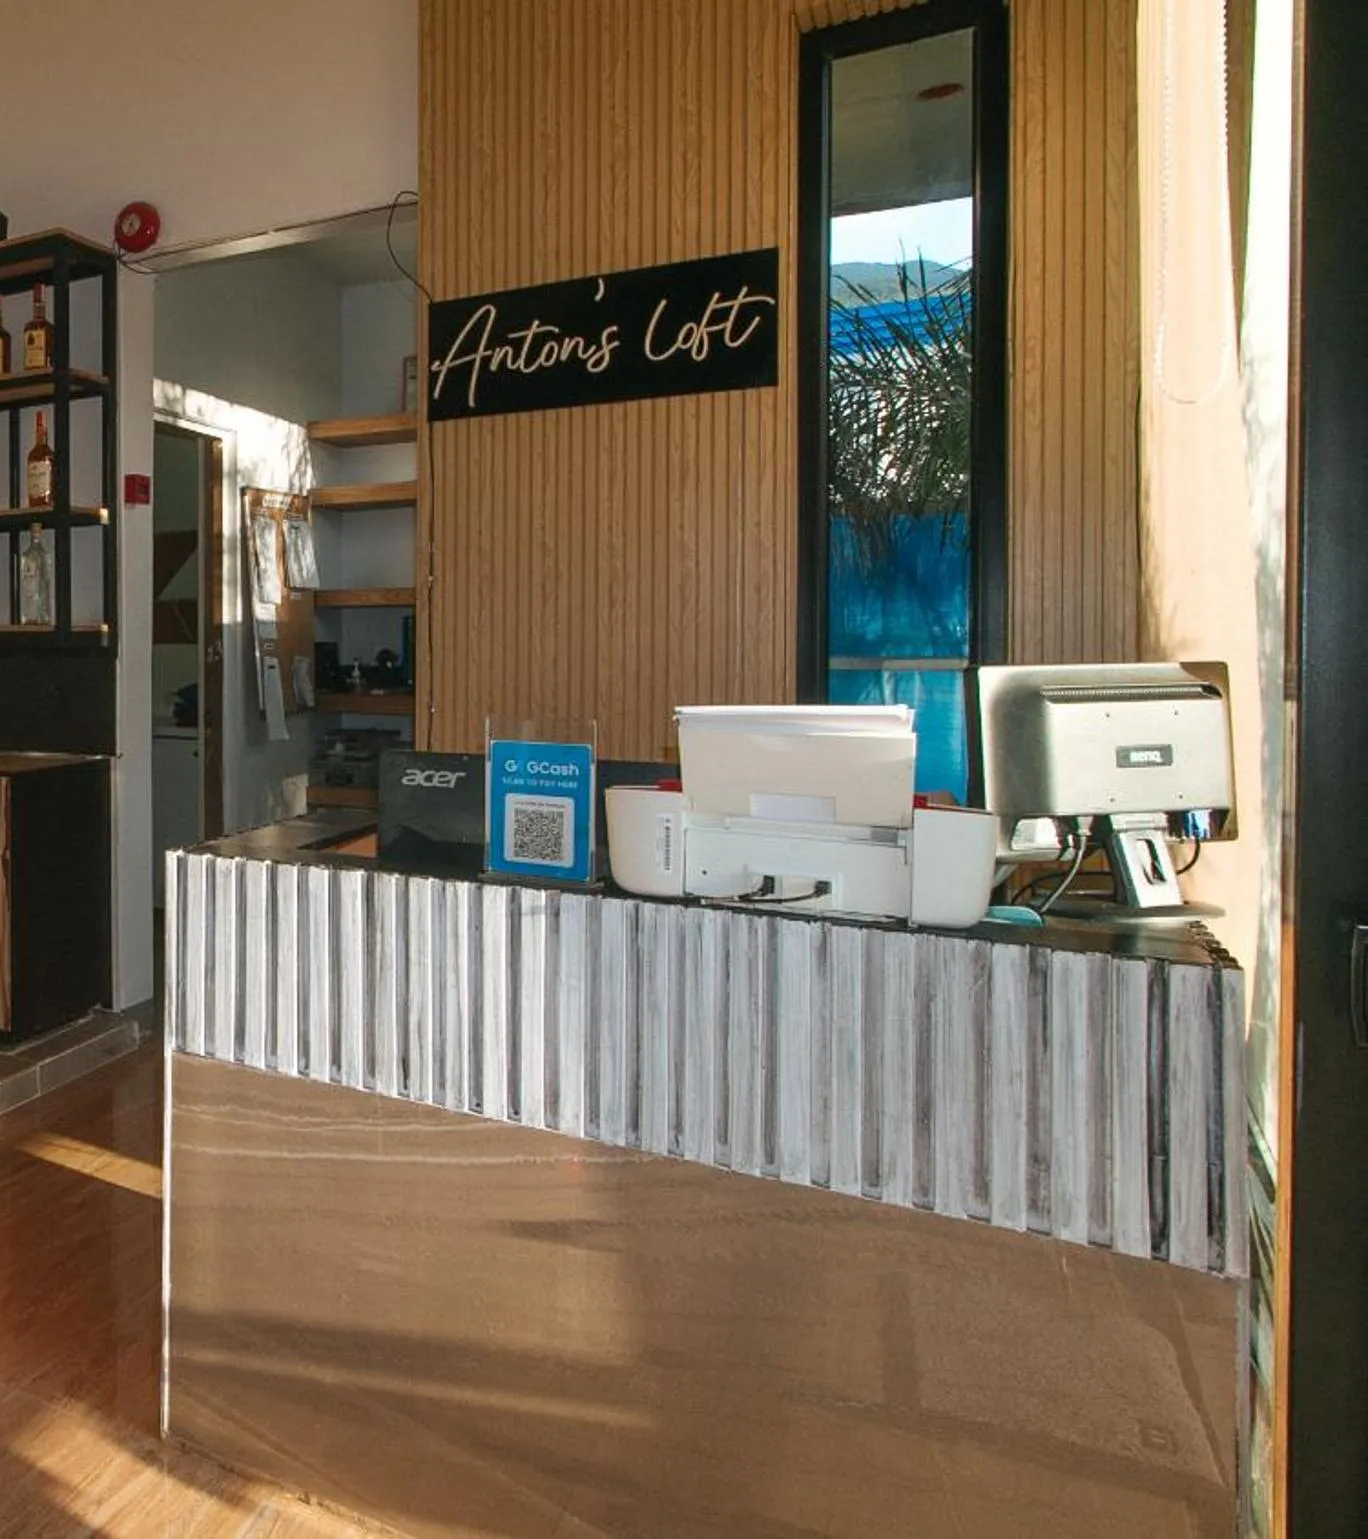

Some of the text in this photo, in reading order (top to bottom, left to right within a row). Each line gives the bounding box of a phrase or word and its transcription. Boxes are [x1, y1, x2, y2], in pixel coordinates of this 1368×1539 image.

[431, 277, 776, 408] Anton's Loft
[401, 768, 467, 789] acer
[526, 760, 580, 777] GCash
